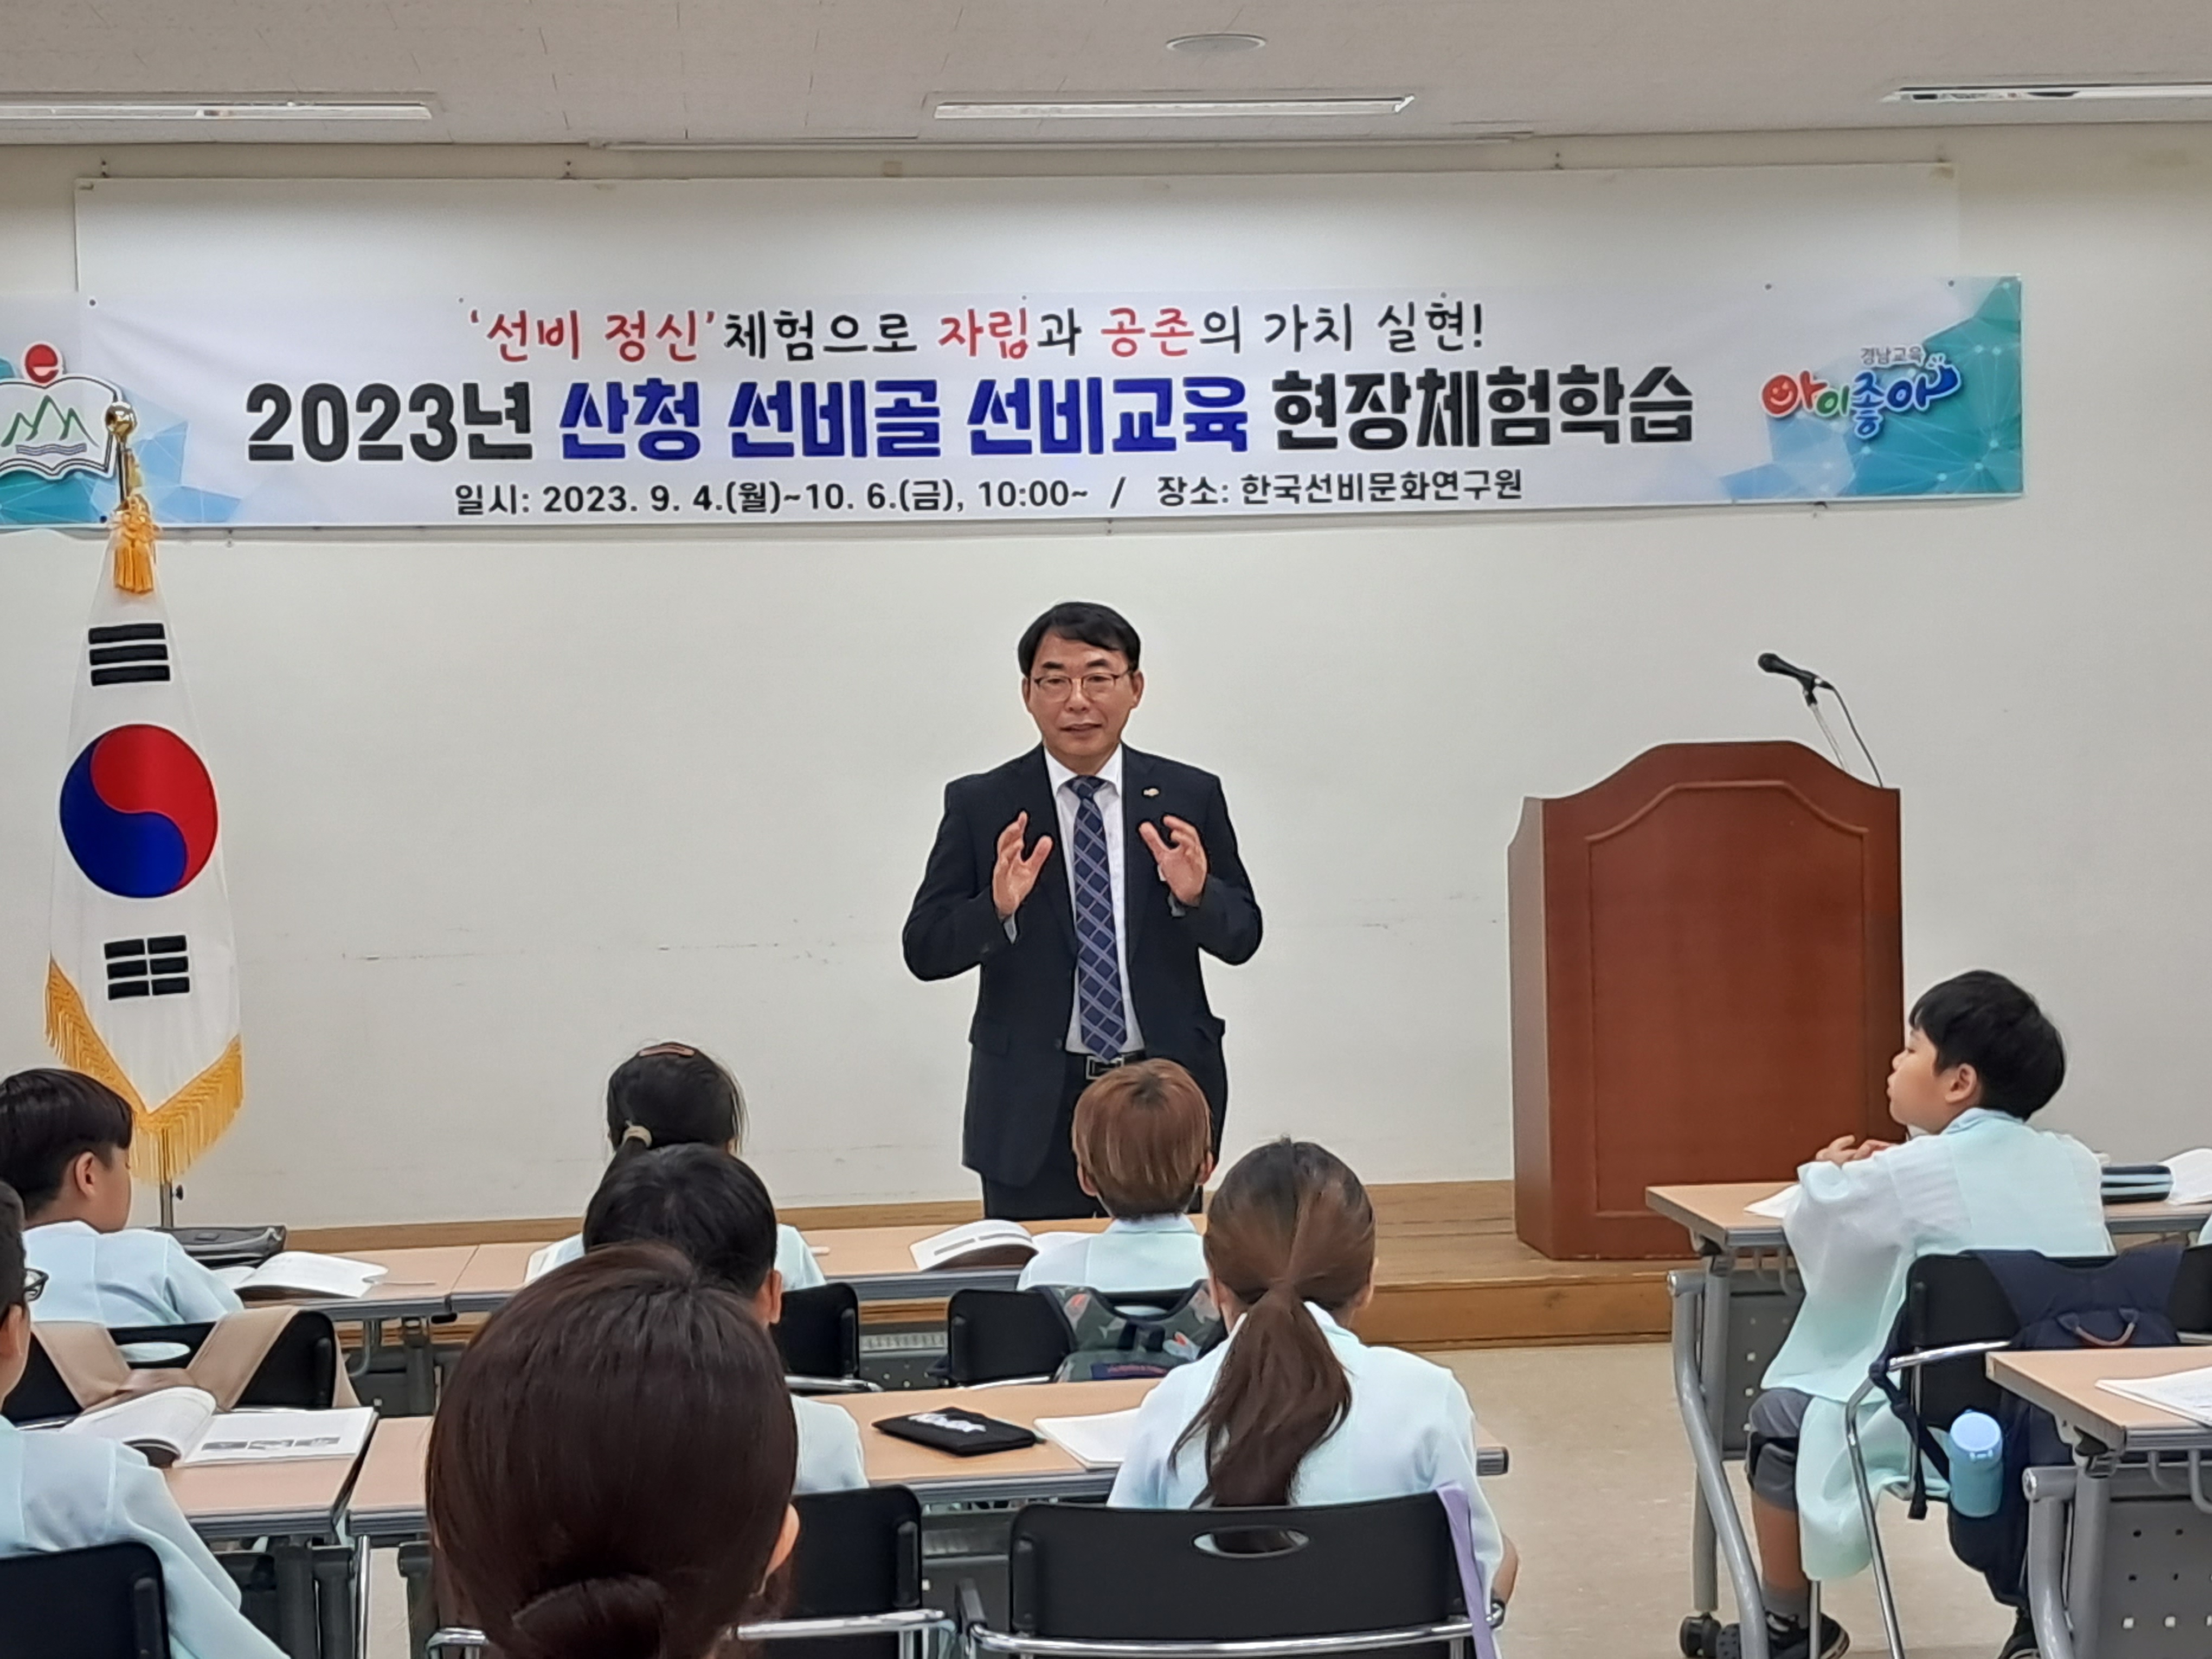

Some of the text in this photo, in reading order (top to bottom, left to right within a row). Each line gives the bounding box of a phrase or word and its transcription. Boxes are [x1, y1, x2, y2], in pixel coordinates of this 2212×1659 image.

[938, 307, 1082, 359] 자립과
[1101, 305, 1240, 357] 공존의
[1265, 303, 1352, 352] 가치
[1378, 301, 1482, 353] 실현!
[1861, 347, 1923, 365] 경남교육
[247, 364, 1693, 462] 2023년 산청 선비골 선비교육 현장체험학습
[1762, 362, 1958, 434] 아이좋아
[455, 484, 529, 516] 일시:
[543, 485, 637, 512] 2023.
[651, 485, 679, 512] 9.
[867, 479, 963, 512] 6.(금),
[979, 480, 1088, 507] 10:00~
[1110, 477, 1126, 509] /
[1158, 476, 1228, 507] 장소:
[1241, 469, 1522, 504] 한국선비문화연구원
